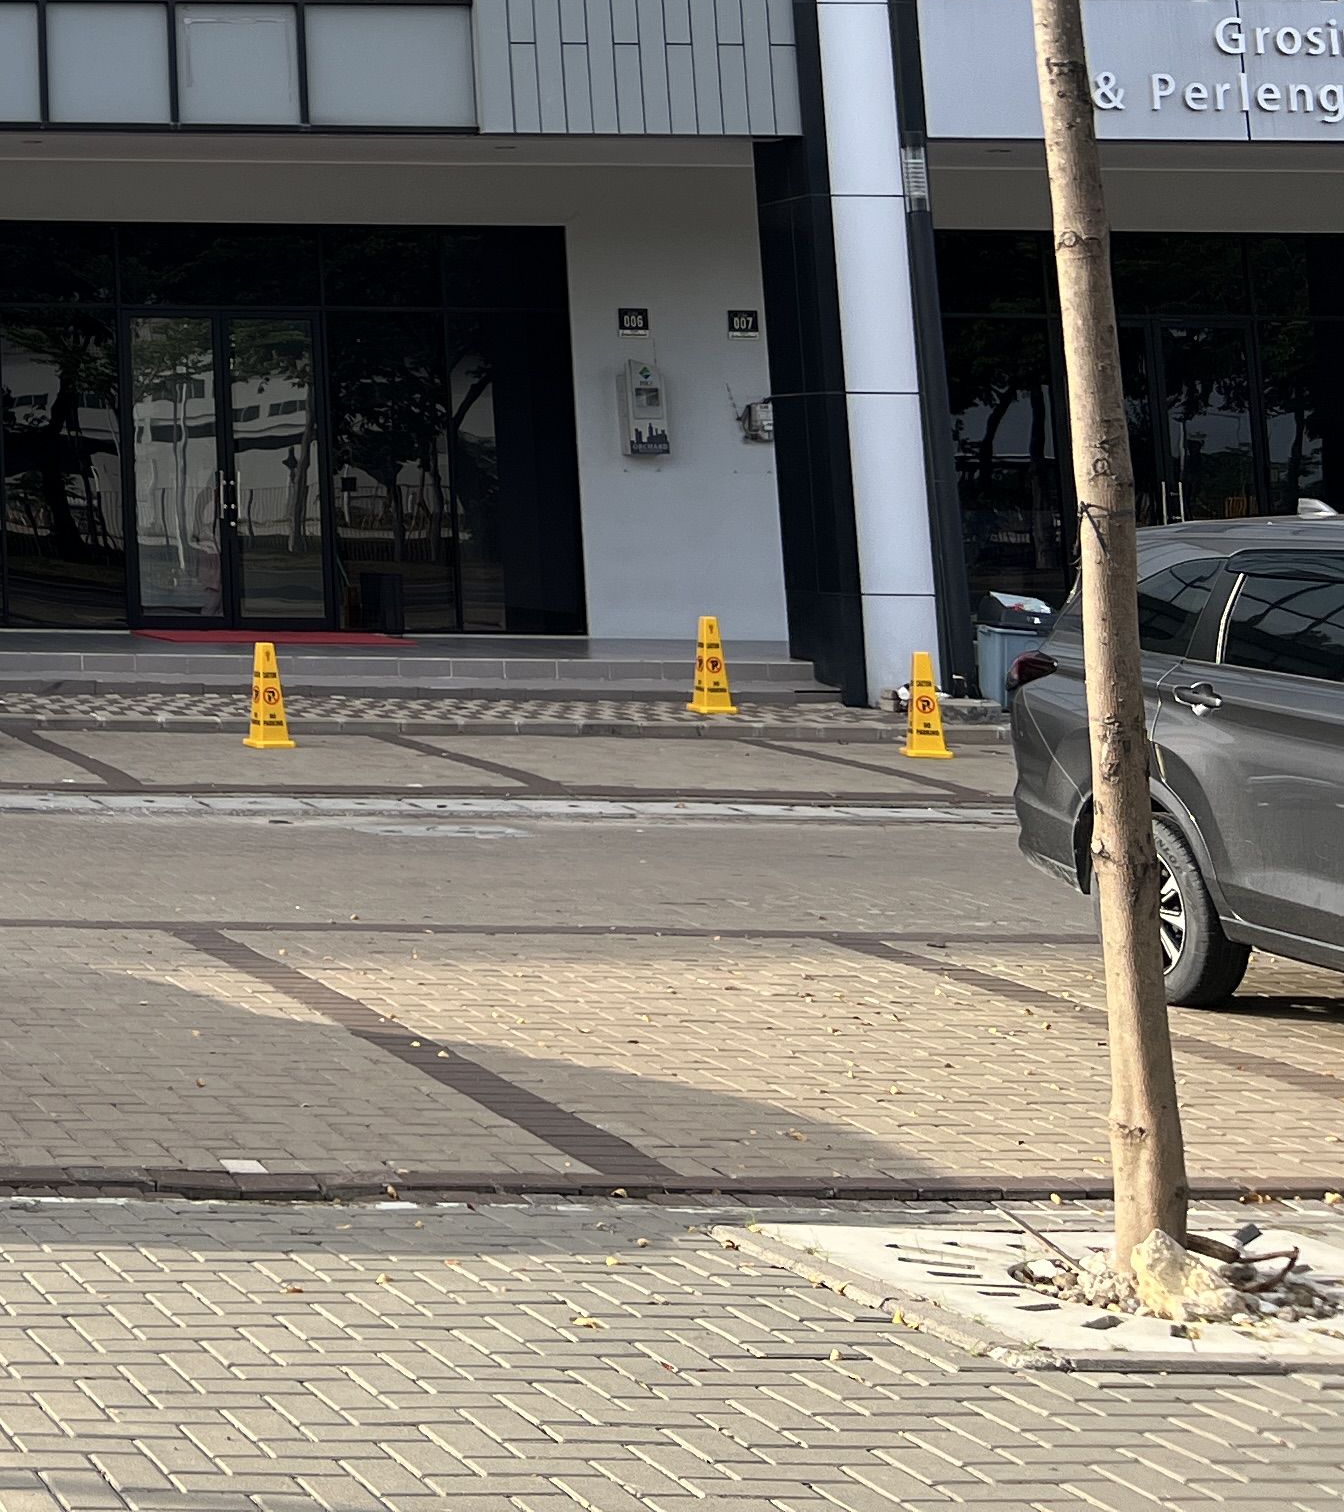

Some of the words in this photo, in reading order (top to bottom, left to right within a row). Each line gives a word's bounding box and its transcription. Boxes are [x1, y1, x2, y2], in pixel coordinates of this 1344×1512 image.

[1214, 16, 1344, 56] Grosi
[1093, 71, 1126, 111] &
[1151, 73, 1344, 123] Perleng
[624, 316, 643, 328] 006
[734, 318, 752, 330] 007
